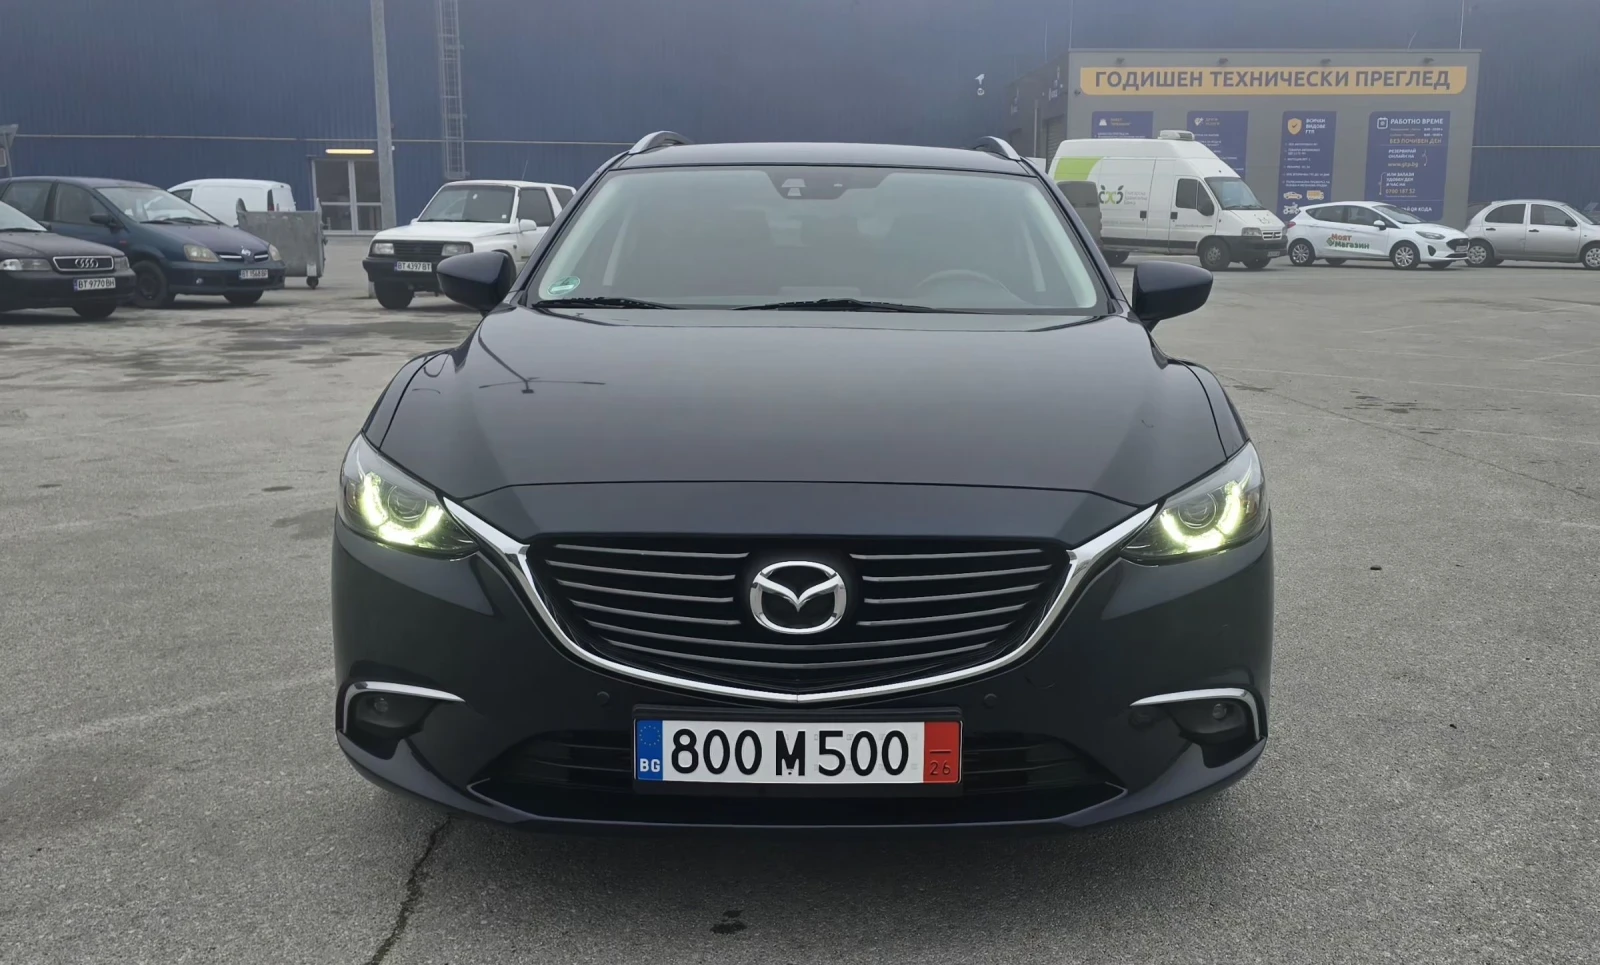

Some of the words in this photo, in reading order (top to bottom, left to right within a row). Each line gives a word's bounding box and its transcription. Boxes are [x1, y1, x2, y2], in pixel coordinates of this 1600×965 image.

[1095, 71, 1203, 91] ГОДИШЕН
[1209, 71, 1349, 88] ТЕХНИЧЕСКИ
[1355, 70, 1450, 90] ПРЕГЛЕД
[1331, 233, 1352, 241] Моят
[1334, 240, 1370, 249] Магазин
[406, 262, 421, 271] 4397
[88, 279, 105, 288] 9770
[671, 728, 763, 775] 800
[775, 729, 807, 777] M
[818, 730, 910, 777] 500
[639, 758, 661, 773] BG
[929, 760, 951, 776] 26
